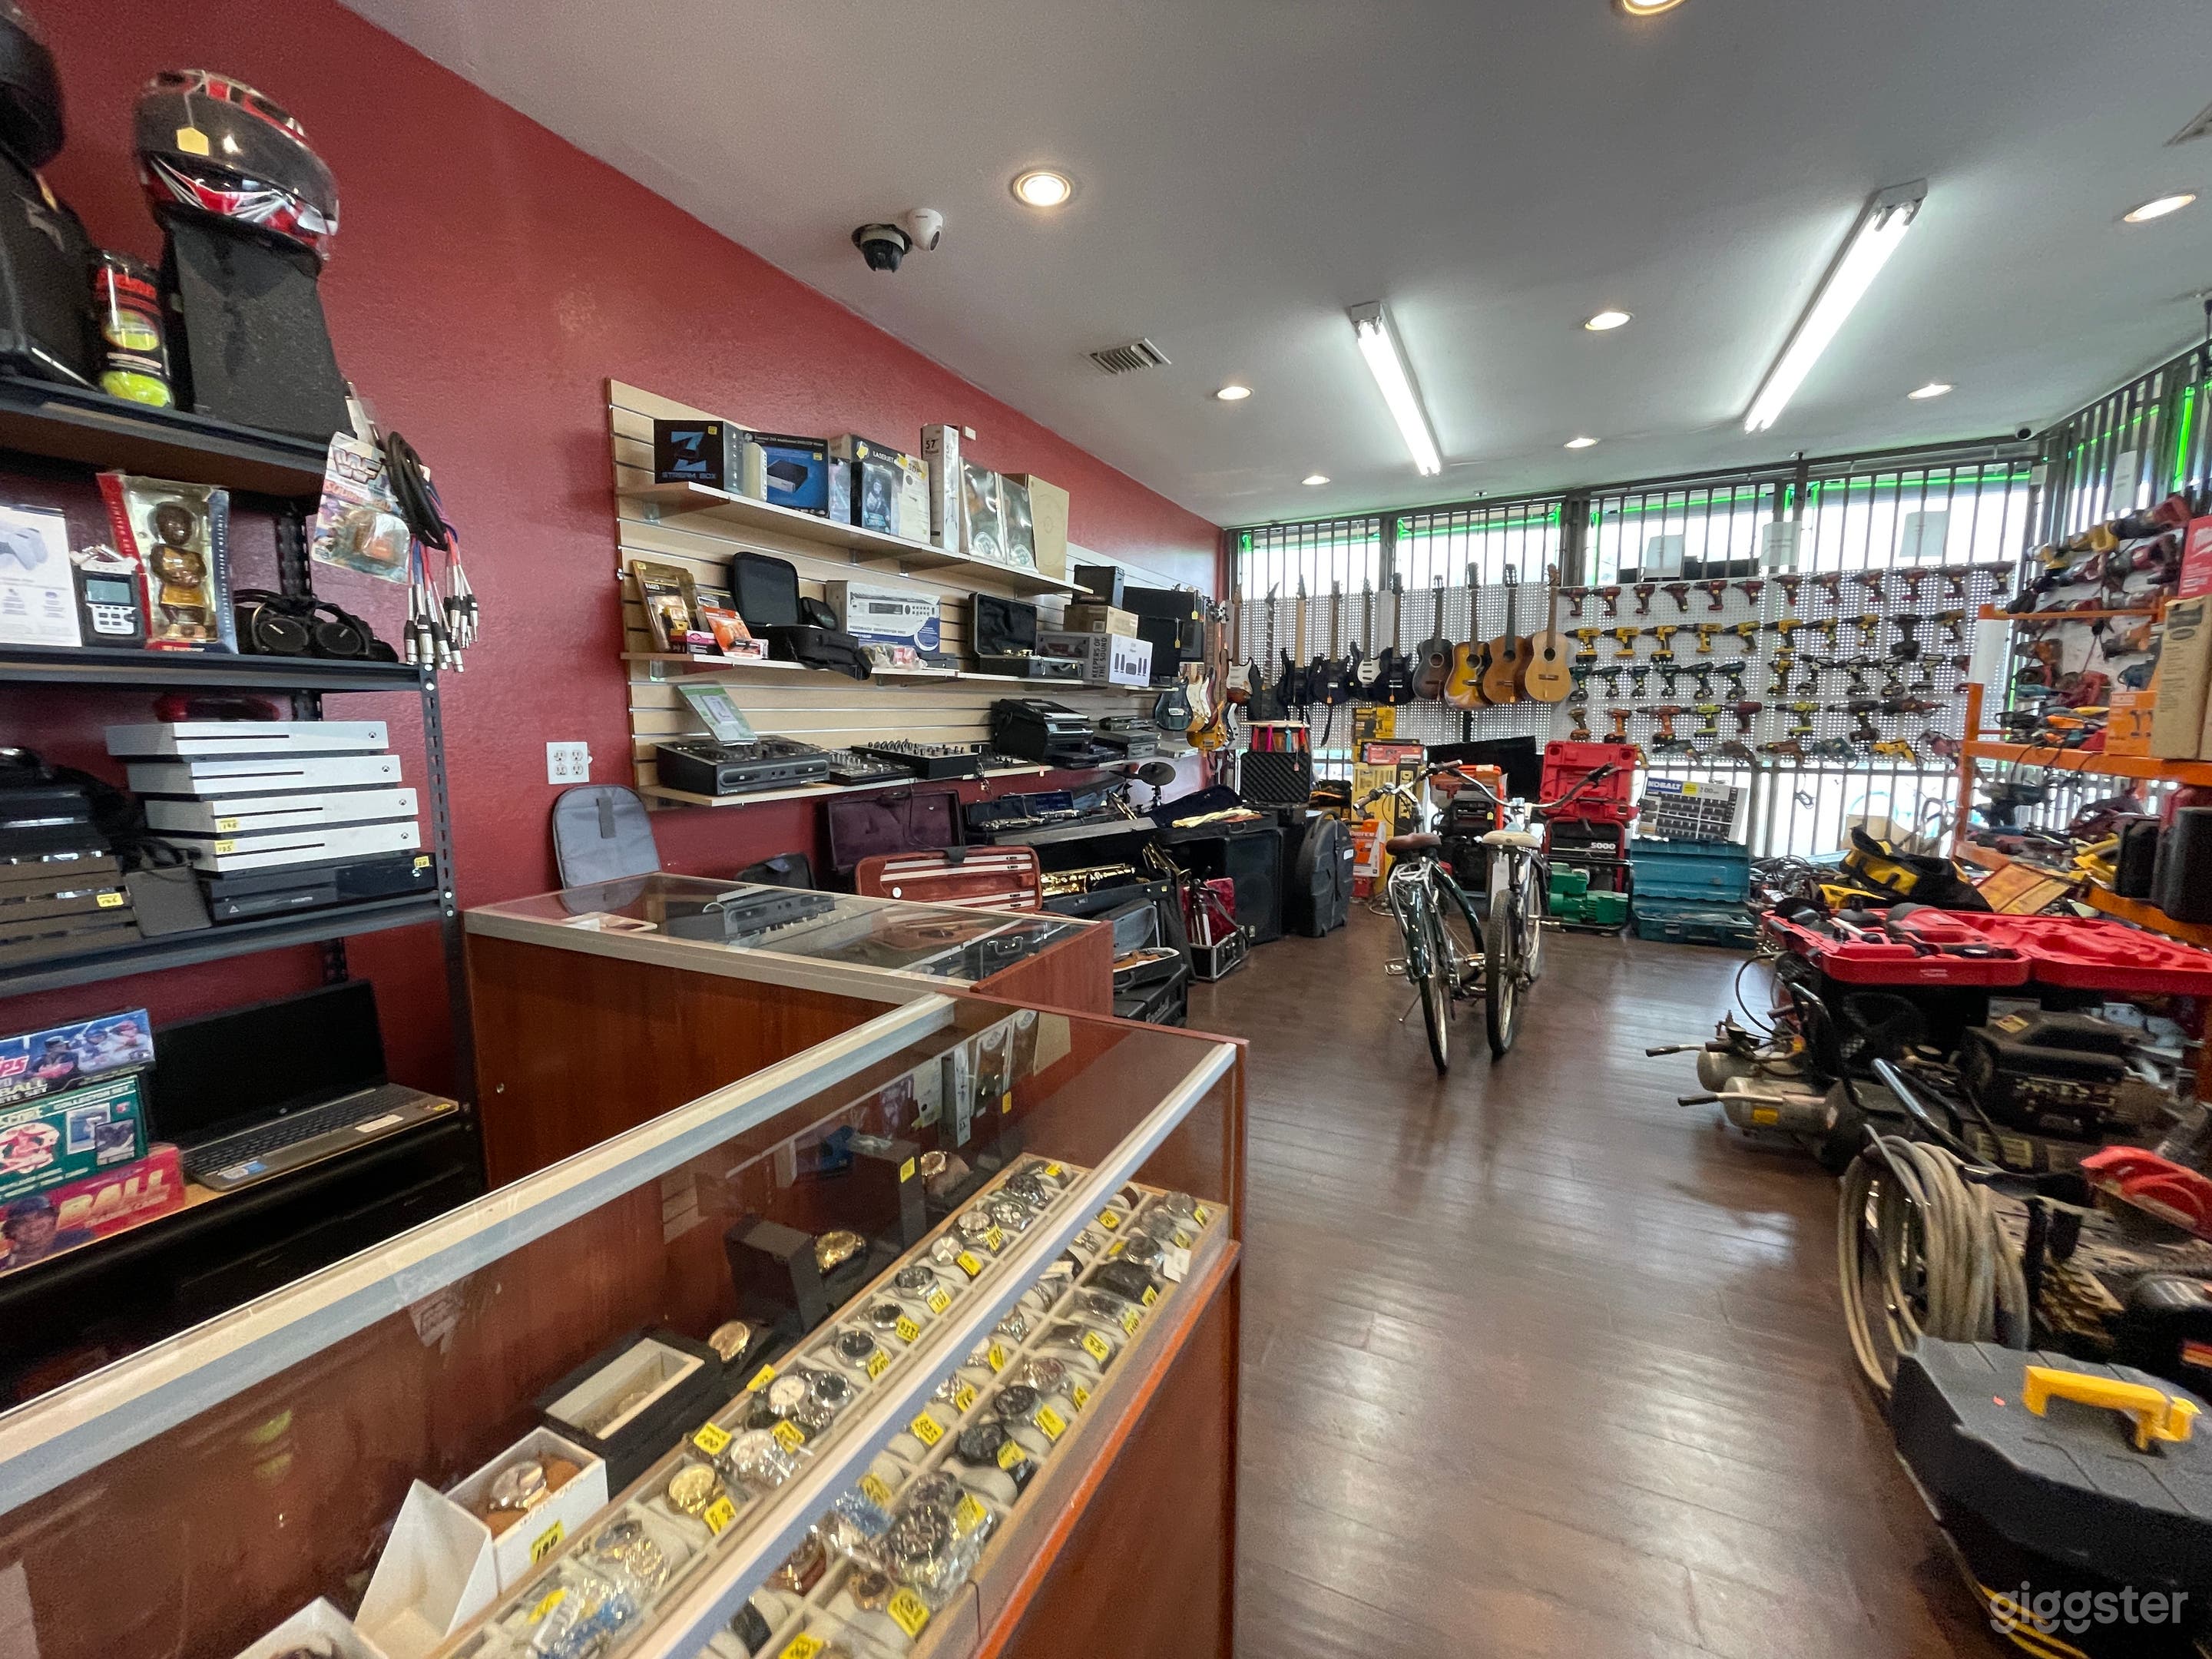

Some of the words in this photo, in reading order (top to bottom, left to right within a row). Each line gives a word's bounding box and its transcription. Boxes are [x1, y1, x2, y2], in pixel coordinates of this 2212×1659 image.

[661, 471, 697, 480] STREAM
[700, 472, 717, 480] BOX
[1647, 780, 1681, 790] KOBALT
